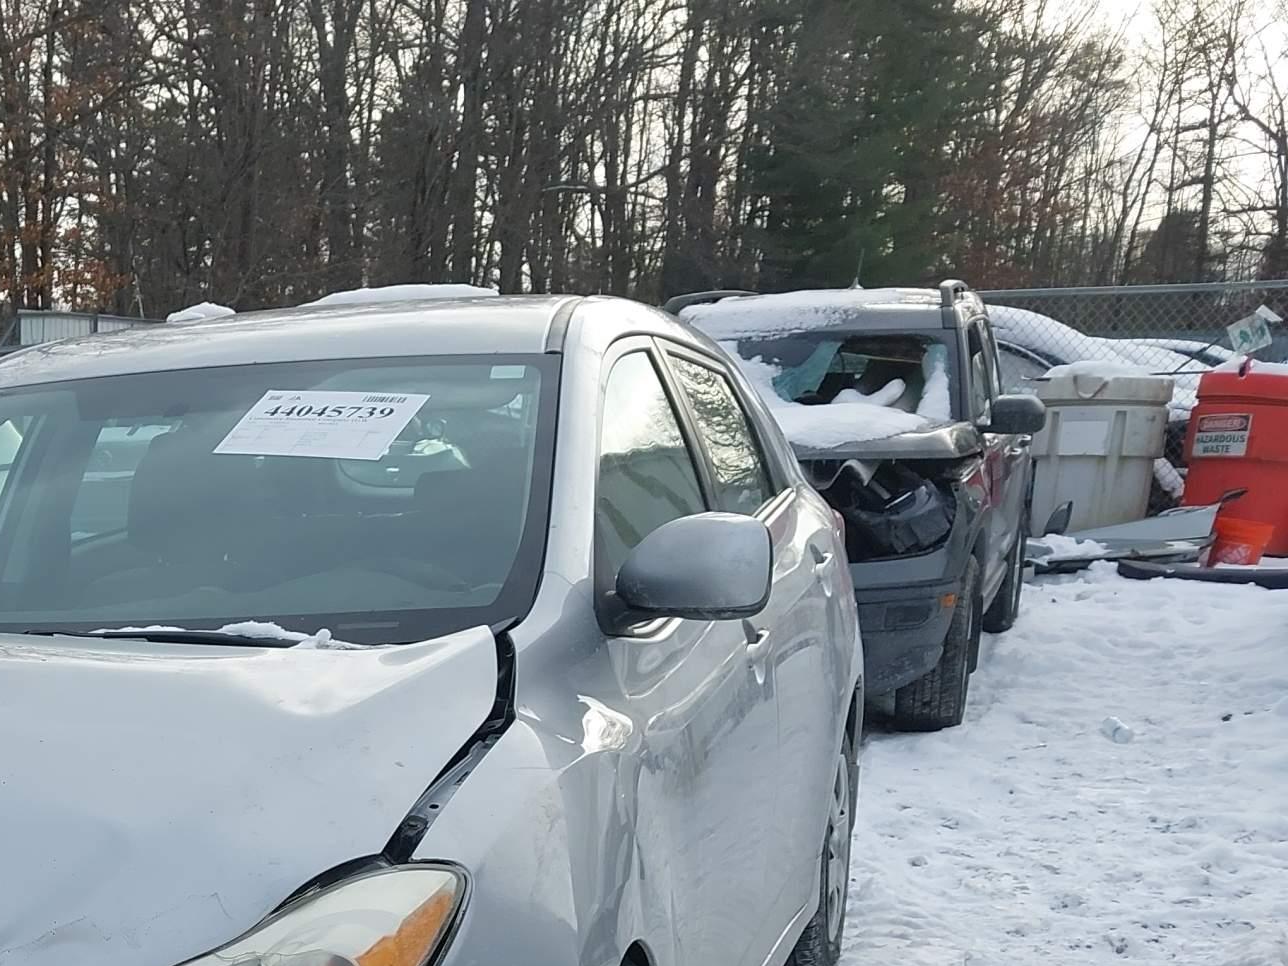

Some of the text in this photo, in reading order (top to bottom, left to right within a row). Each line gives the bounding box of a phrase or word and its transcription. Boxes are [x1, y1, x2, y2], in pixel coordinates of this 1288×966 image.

[264, 404, 395, 419] 44045739
[1197, 434, 1246, 443] HAZARDOUS
[1202, 445, 1231, 453] WASTE
